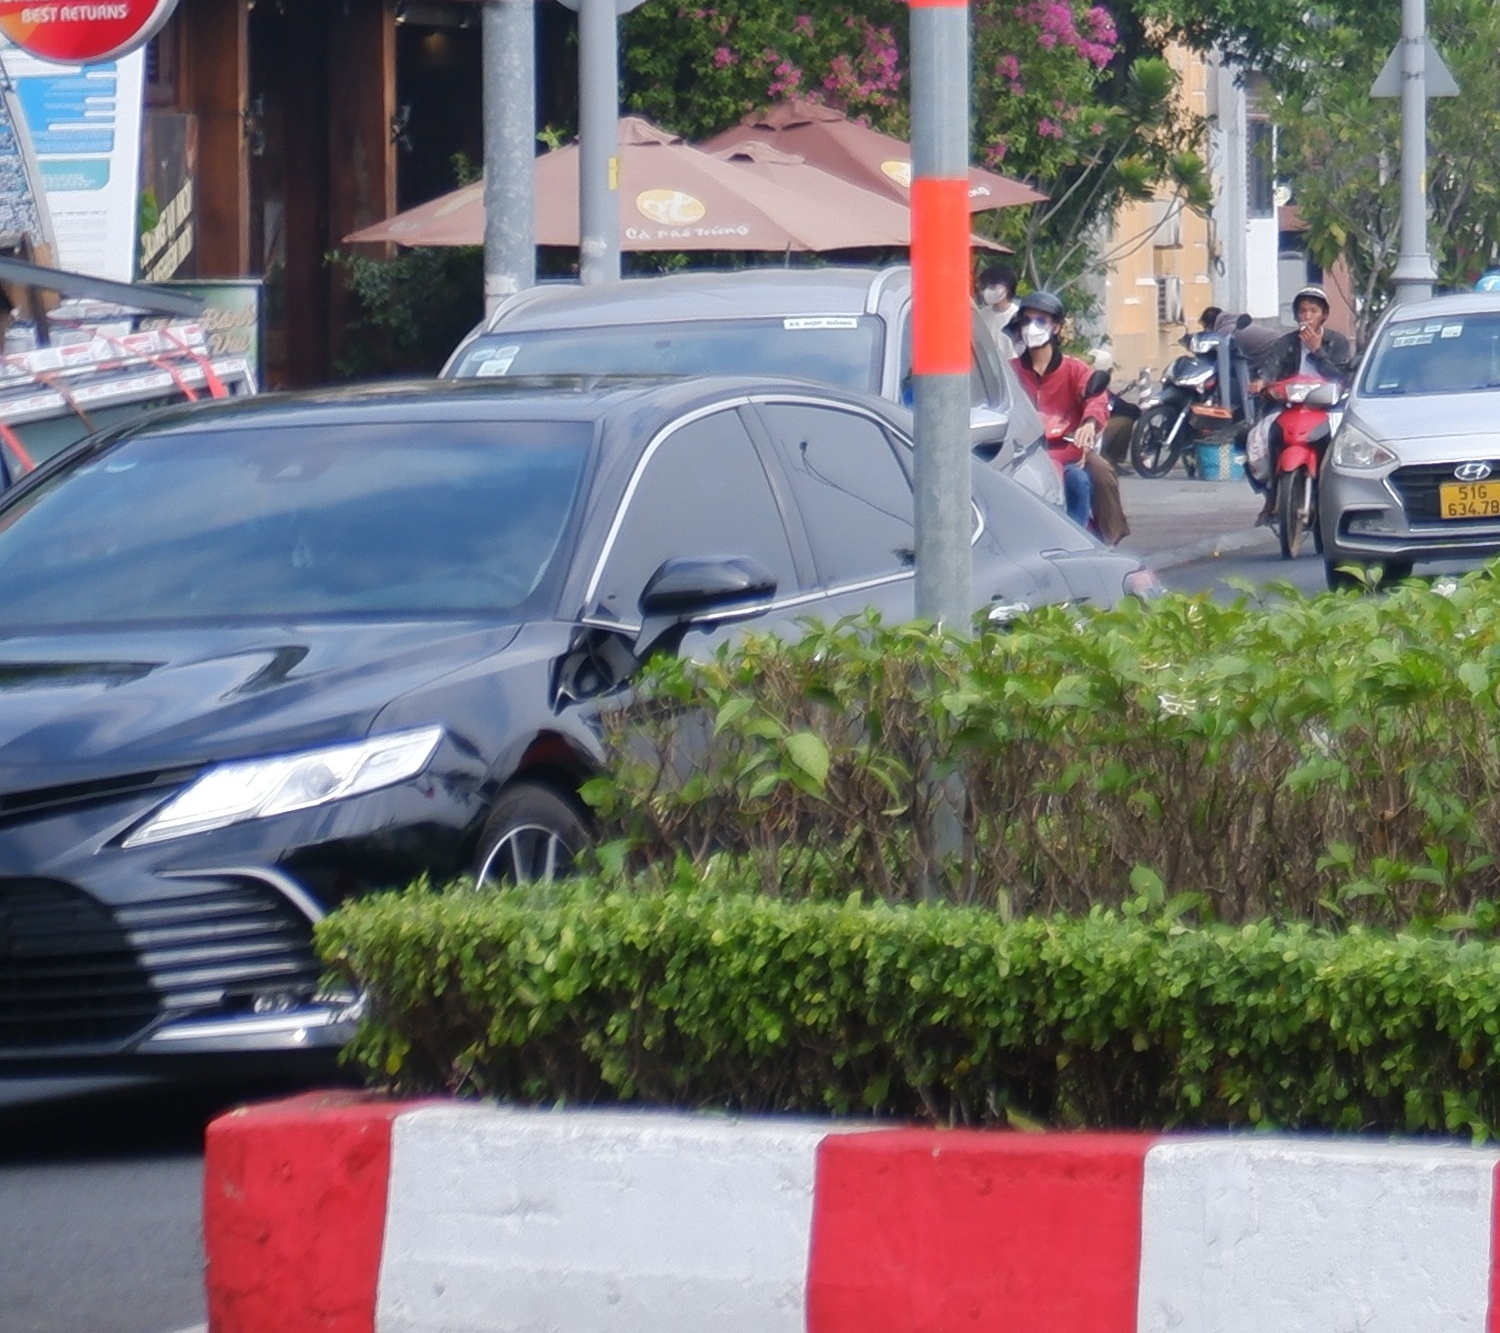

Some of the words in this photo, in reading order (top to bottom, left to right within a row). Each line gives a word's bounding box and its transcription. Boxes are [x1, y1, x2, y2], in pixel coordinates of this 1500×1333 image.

[21, 6, 58, 23] BEST
[60, 3, 128, 22] RETURNS
[1459, 485, 1488, 500] 51G
[1448, 500, 1500, 516] 634.78
